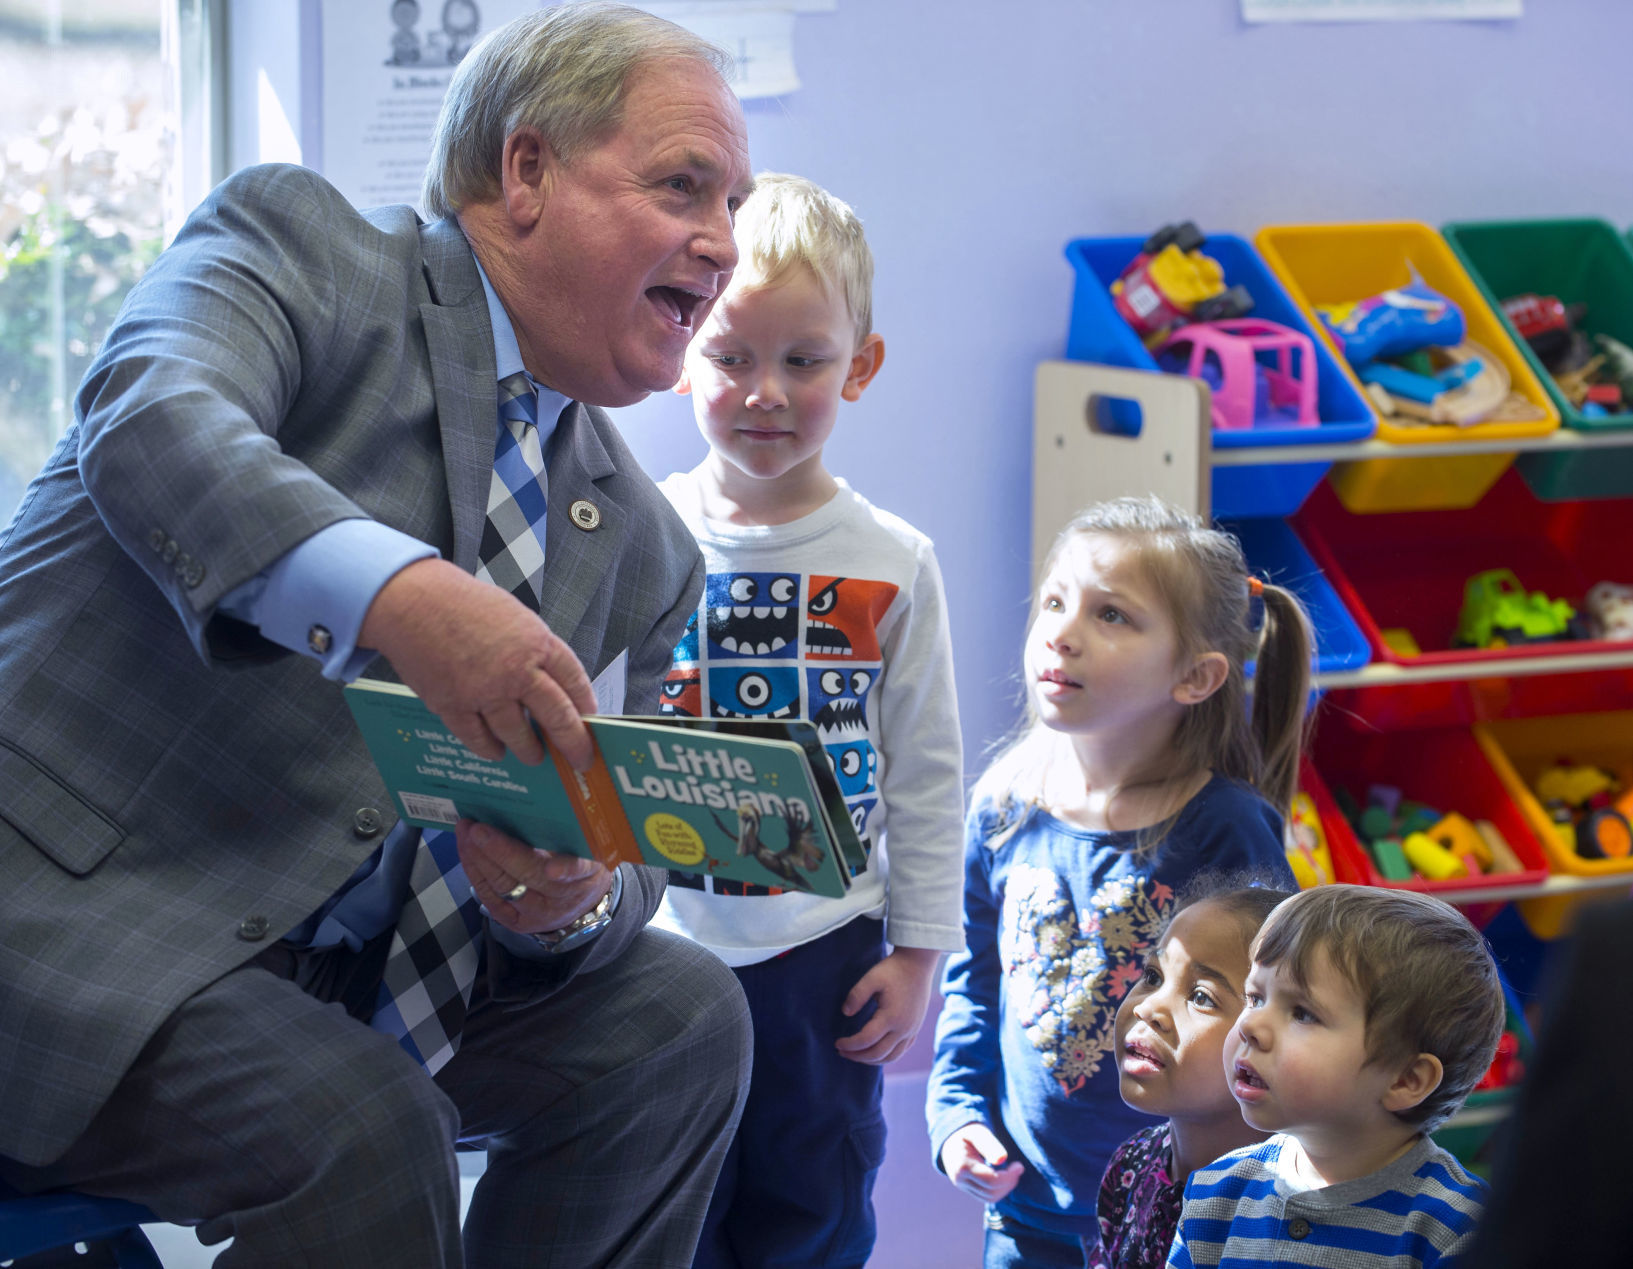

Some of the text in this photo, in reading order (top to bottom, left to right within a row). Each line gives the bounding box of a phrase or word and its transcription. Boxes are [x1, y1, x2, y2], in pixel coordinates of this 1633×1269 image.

[414, 728, 445, 743] Little
[428, 743, 460, 757] Little
[648, 741, 757, 784] Little
[416, 765, 446, 778] Little
[482, 775, 529, 794] Carolina
[423, 754, 454, 768] Little
[455, 759, 510, 779] California
[614, 765, 811, 823] Louisiana
